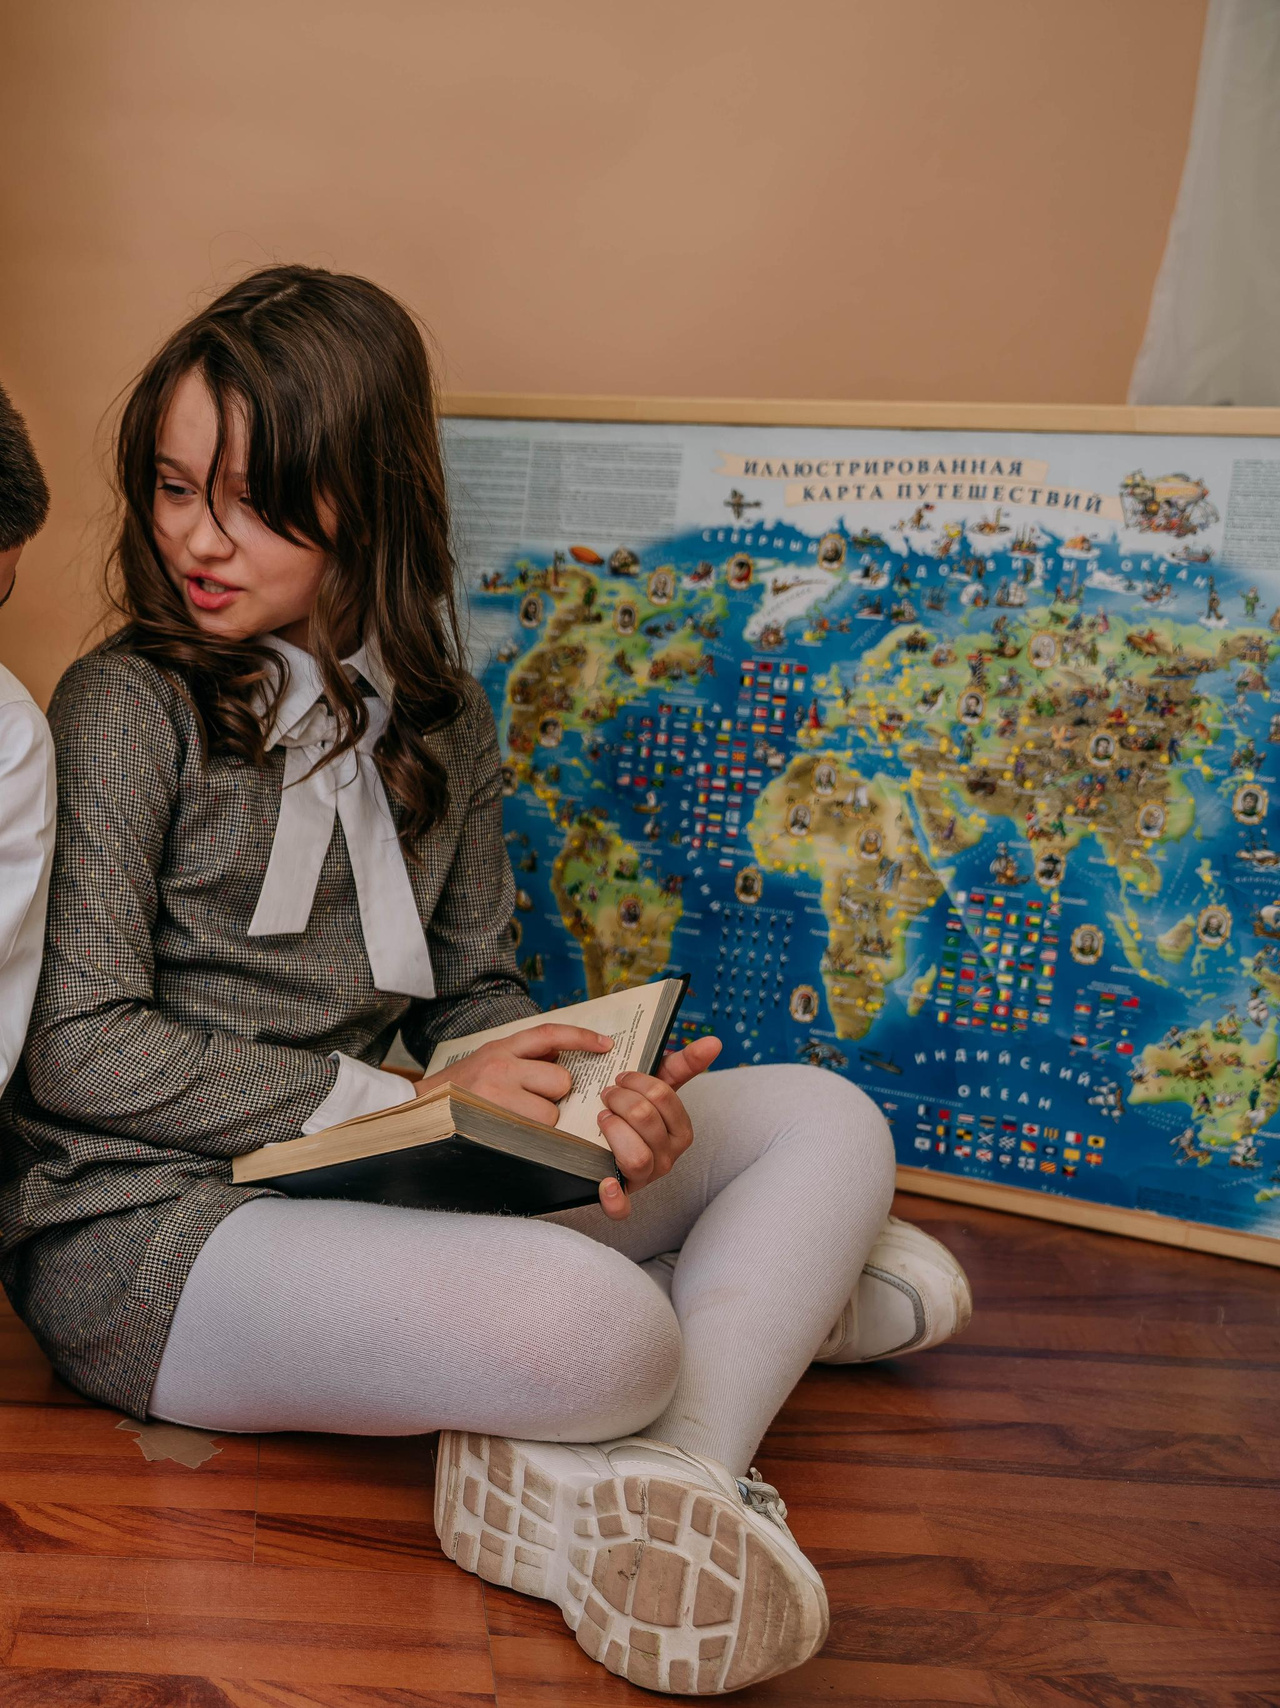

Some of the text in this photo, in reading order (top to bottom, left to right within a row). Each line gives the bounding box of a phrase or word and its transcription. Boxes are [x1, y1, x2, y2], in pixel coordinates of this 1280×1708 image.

[743, 458, 1024, 478] ИЛЛЮСТРИРОВАННАЯ
[802, 482, 1103, 514] КАРТА ПУТЕШЕСТВИЙ
[1121, 559, 1207, 588] ОКЕАН
[914, 1048, 1091, 1087] ИНДИЙСКИЙ
[958, 1084, 1052, 1111] ОКЕАН
